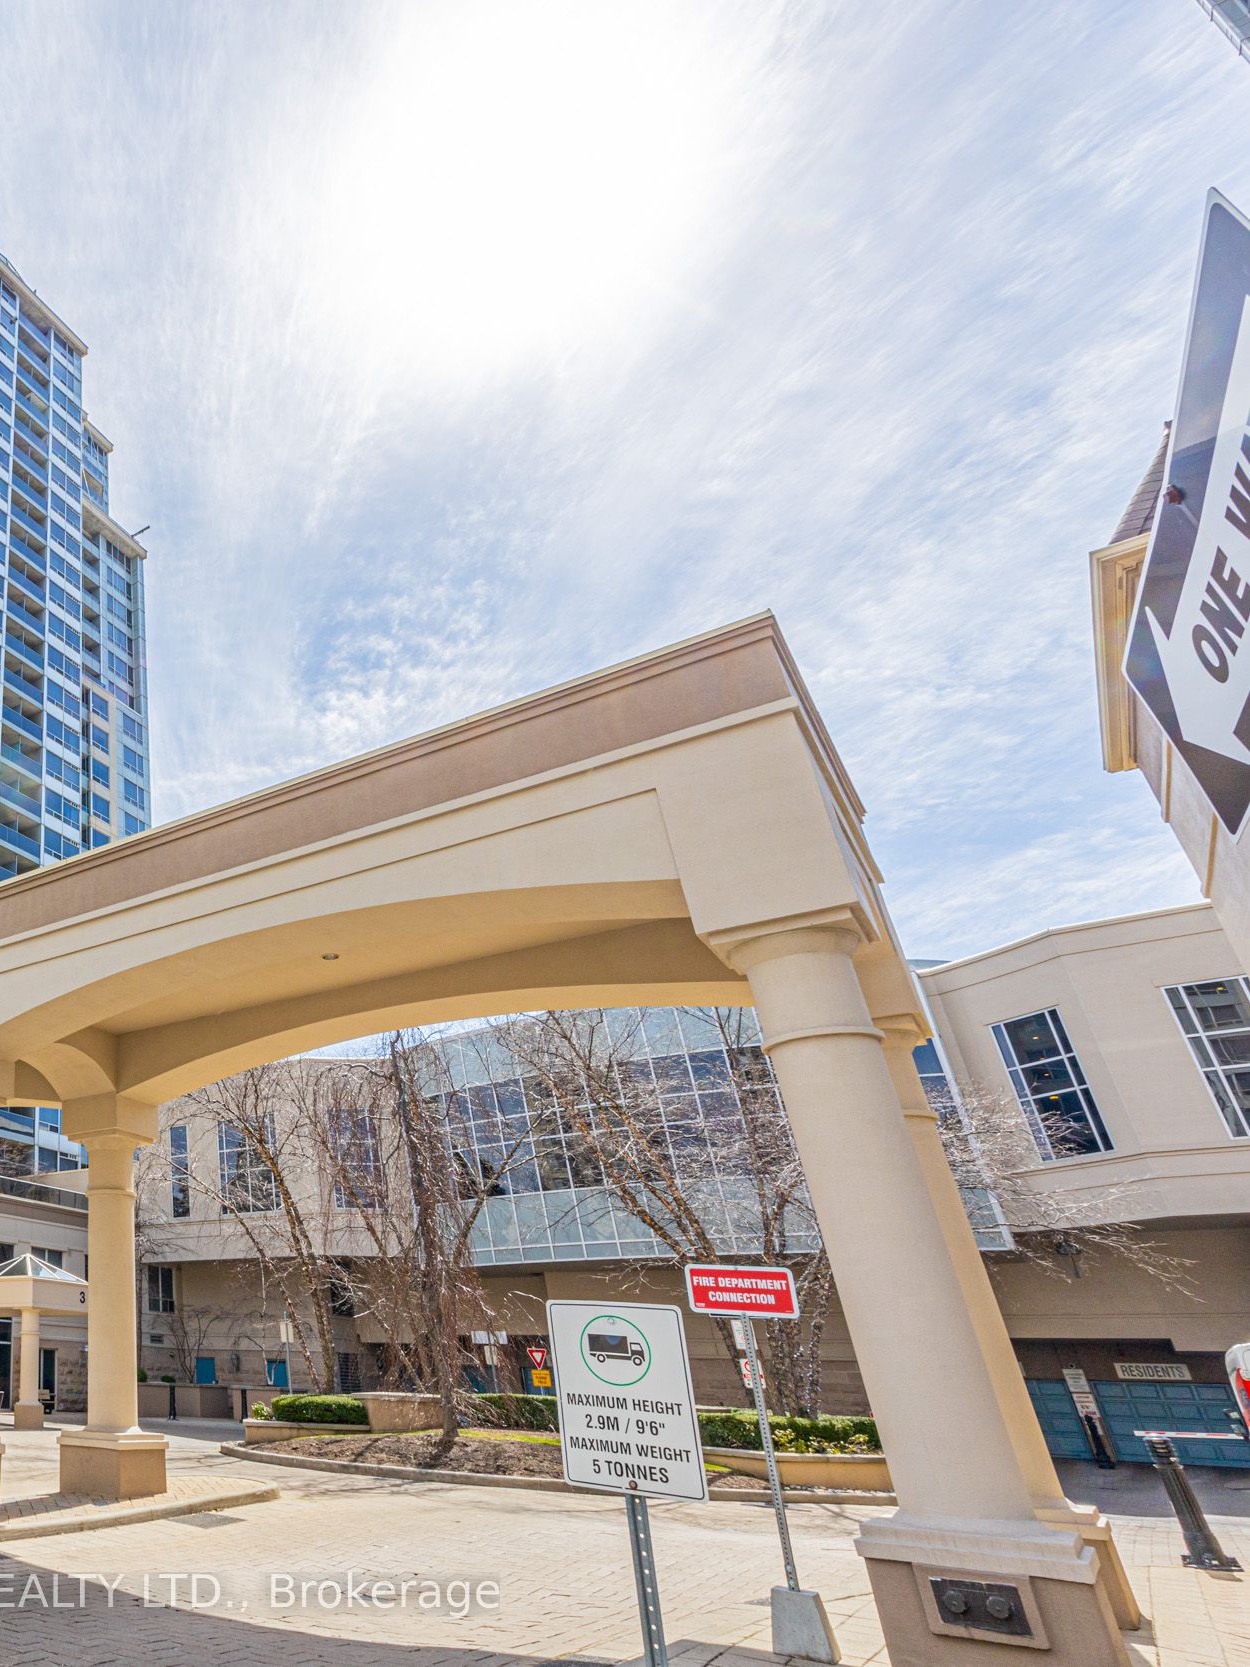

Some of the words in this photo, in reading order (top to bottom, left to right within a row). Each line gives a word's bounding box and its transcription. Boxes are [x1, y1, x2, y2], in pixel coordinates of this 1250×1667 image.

[1192, 545, 1250, 683] ONE
[692, 1276, 716, 1287] FIRE
[718, 1277, 787, 1290] DEPARTMENT
[79, 1291, 86, 1304] 3
[708, 1291, 776, 1305] CONNECTION
[1120, 1364, 1185, 1378] RESIDENTS
[566, 1392, 628, 1410] MAXIMUM
[632, 1398, 683, 1416] HEIGHT
[585, 1413, 620, 1431] 2.9M
[636, 1419, 666, 1436] 9'6"
[570, 1436, 632, 1455] MAXIMUM
[636, 1443, 692, 1463] WEIGHT
[592, 1459, 601, 1474] 5
[605, 1460, 670, 1484] TONNES
